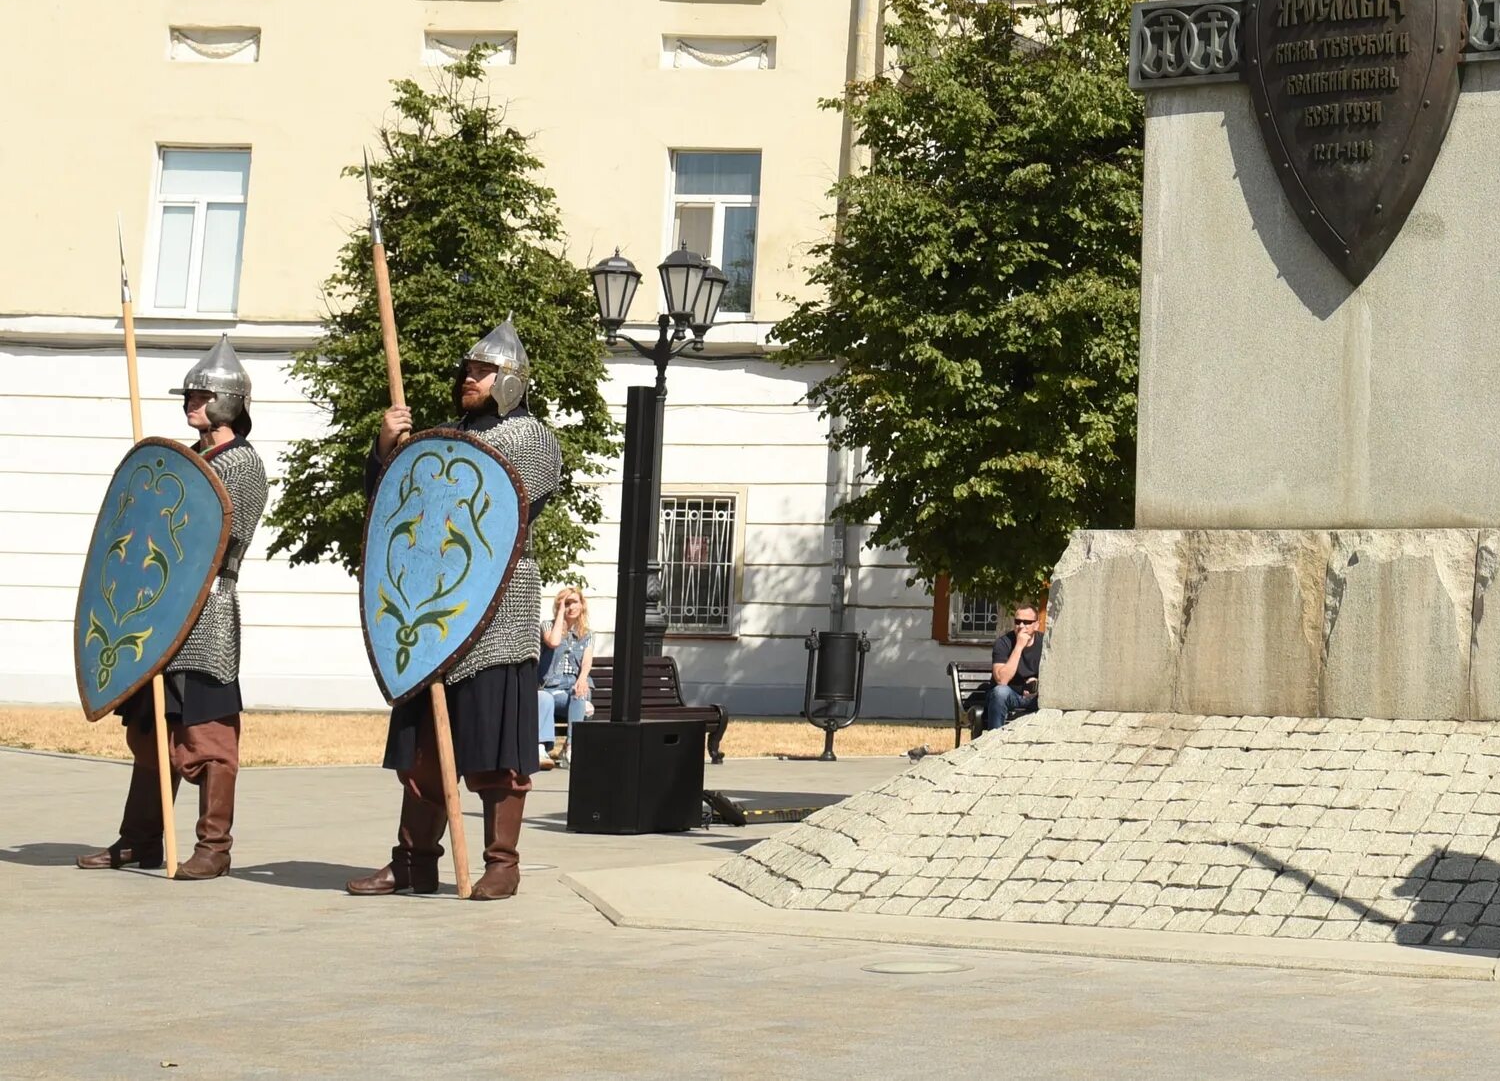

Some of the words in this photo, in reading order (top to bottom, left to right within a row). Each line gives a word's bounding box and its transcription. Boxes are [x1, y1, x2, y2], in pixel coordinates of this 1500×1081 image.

[1276, 40, 1318, 64] КНЯЗЬ
[1321, 28, 1395, 58] ТВЕРСКОЙ
[1400, 31, 1410, 54] И
[1287, 65, 1347, 95] ВЕЛИКИЙ
[1351, 66, 1400, 91] КНЯЗЬ
[1304, 103, 1340, 127] ВСЕЯ
[1345, 101, 1382, 128] РУСИ
